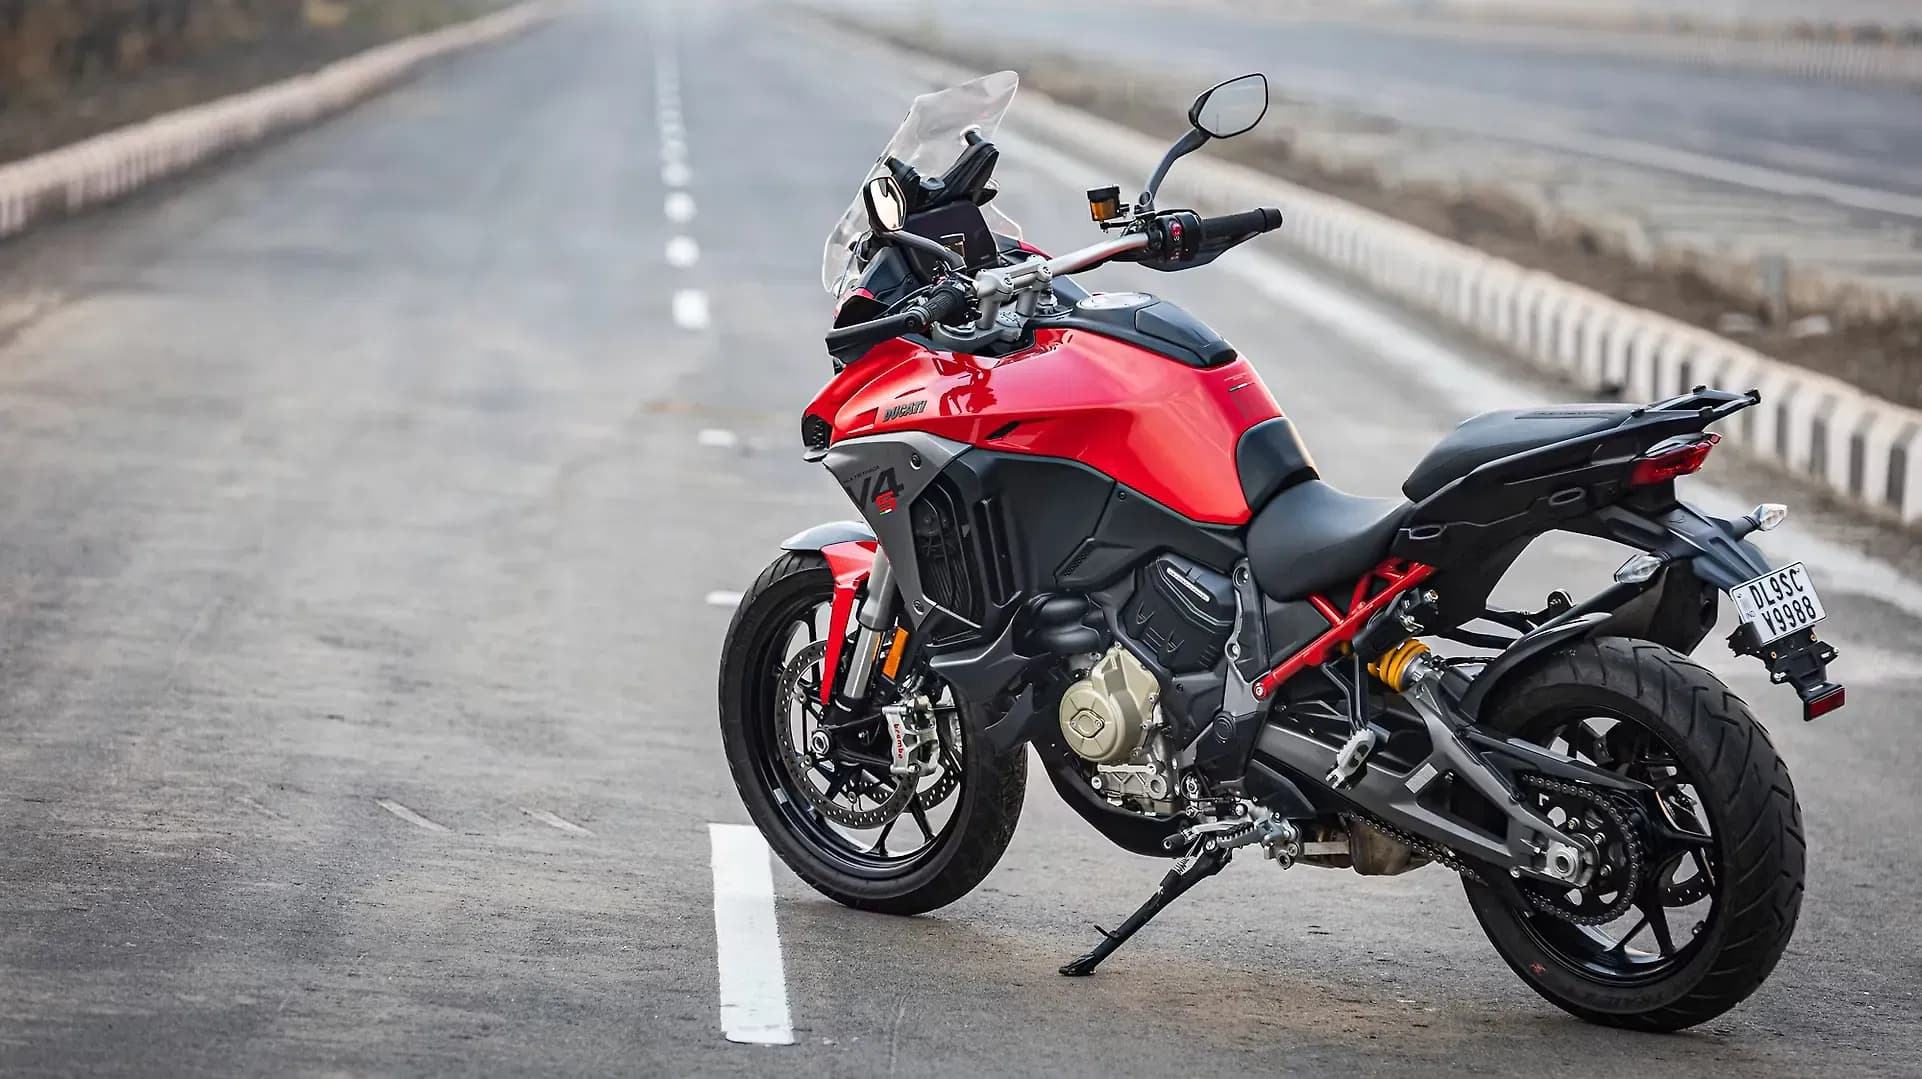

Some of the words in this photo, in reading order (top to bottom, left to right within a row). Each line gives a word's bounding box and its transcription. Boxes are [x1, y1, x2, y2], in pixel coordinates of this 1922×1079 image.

[883, 400, 928, 422] DUCATI
[1748, 568, 1804, 610] DL9SC
[1761, 595, 1817, 636] Y9988
